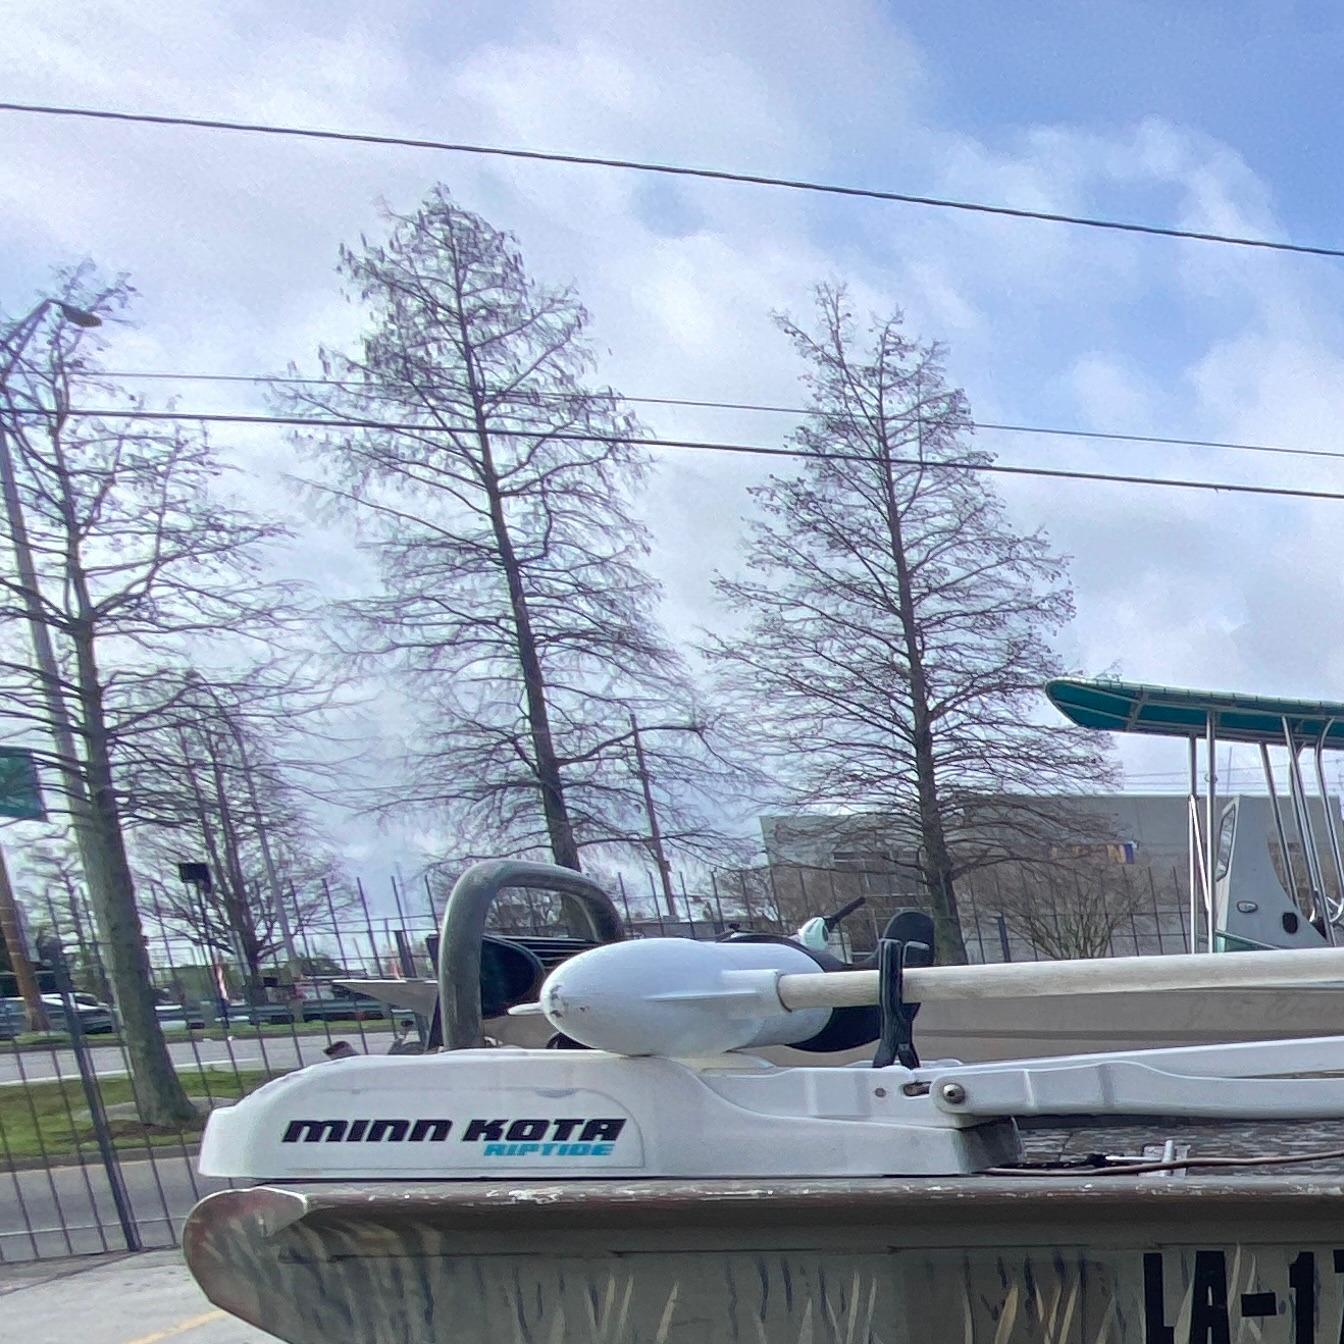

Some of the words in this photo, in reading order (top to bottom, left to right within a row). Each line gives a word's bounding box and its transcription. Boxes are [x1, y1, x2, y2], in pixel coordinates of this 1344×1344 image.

[281, 1119, 453, 1143] MINN
[462, 1118, 627, 1142] KOTA
[484, 1143, 616, 1157] RIPTIDE
